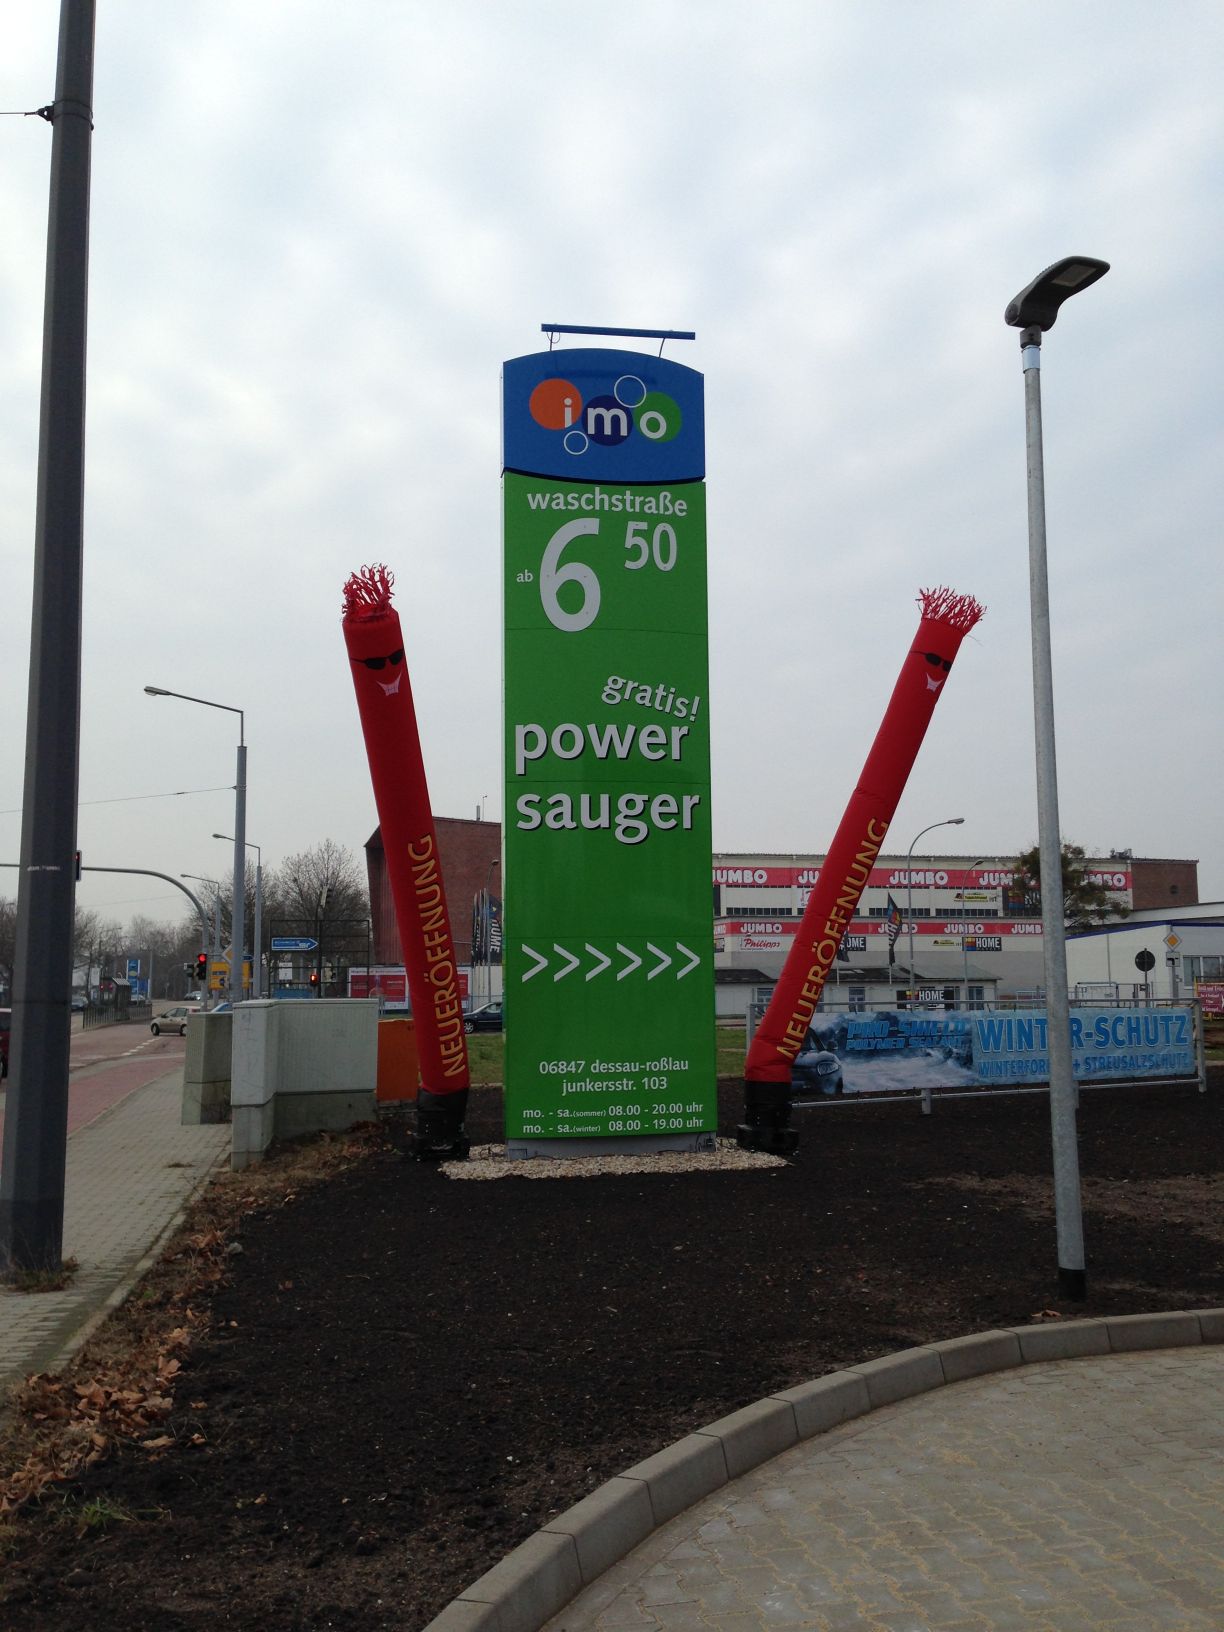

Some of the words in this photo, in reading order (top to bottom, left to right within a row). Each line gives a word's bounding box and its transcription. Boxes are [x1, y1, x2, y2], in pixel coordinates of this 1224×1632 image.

[564, 398, 667, 440] imo
[527, 487, 688, 517] waschstraße
[516, 570, 534, 583] ab
[539, 517, 601, 632] 6
[624, 521, 678, 572] 50
[601, 675, 701, 722] gratis!
[515, 722, 690, 776] power
[516, 793, 701, 845] sauger
[713, 869, 768, 884] UMBO
[889, 871, 949, 885] JUMBO
[741, 923, 783, 934] JUMBO
[1011, 924, 1043, 934] JUMB
[776, 818, 889, 1058] NEUERÖFFNUNG
[847, 938, 865, 948] OME
[976, 938, 1001, 948] HOME
[408, 834, 466, 1077] NEUERÖFFNUNG
[919, 990, 945, 1001] HOME
[977, 1014, 1189, 1053] WINTR-SCHUTZ
[539, 1060, 585, 1074] 06847
[591, 1057, 689, 1073] dessau-roßlau
[562, 1077, 636, 1096] junkersstr.
[642, 1076, 668, 1090] 103
[523, 1109, 545, 1119] mo.
[608, 1105, 641, 1117] 08.00
[652, 1103, 683, 1115] 20.00
[686, 1102, 704, 1113] uhr
[523, 1124, 545, 1134] mo.
[608, 1119, 641, 1131] 08.00
[652, 1118, 683, 1130] 19.00
[686, 1117, 704, 1129] uhr
